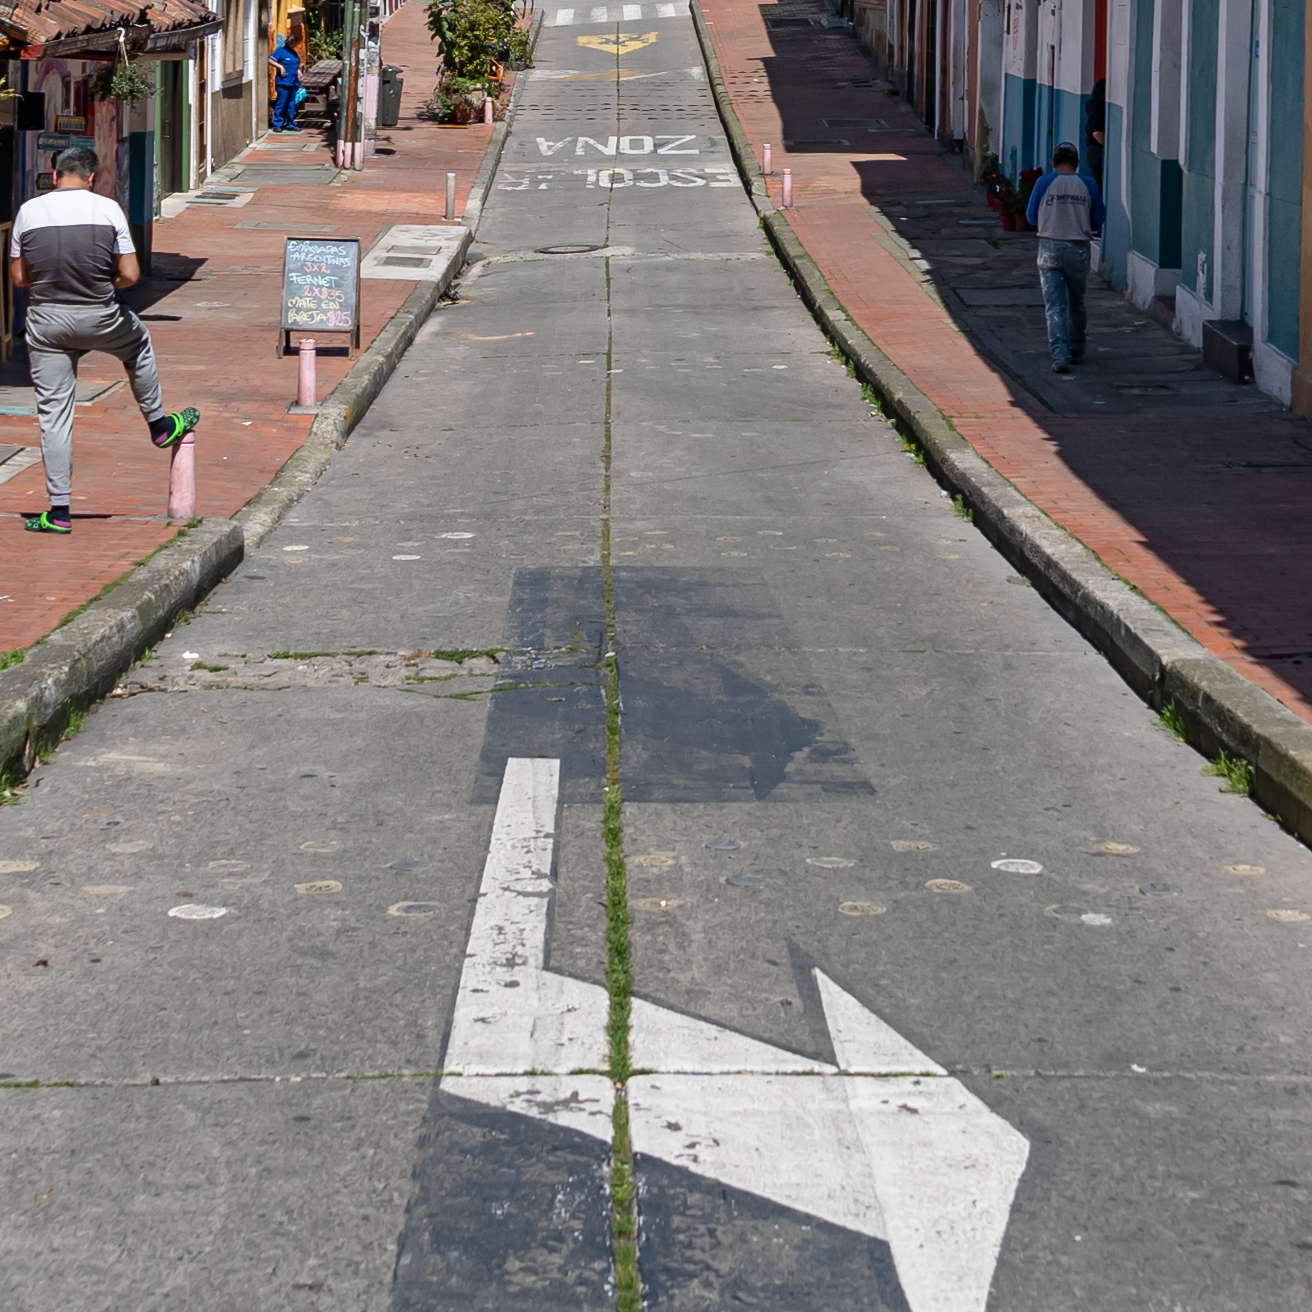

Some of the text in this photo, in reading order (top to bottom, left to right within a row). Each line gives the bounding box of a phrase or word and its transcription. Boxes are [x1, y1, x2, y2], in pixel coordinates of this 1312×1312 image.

[536, 135, 700, 157] ZONA
[288, 273, 339, 287] FERNET
[288, 296, 340, 310] MATE EN
[288, 308, 352, 327] PAREJA $25
